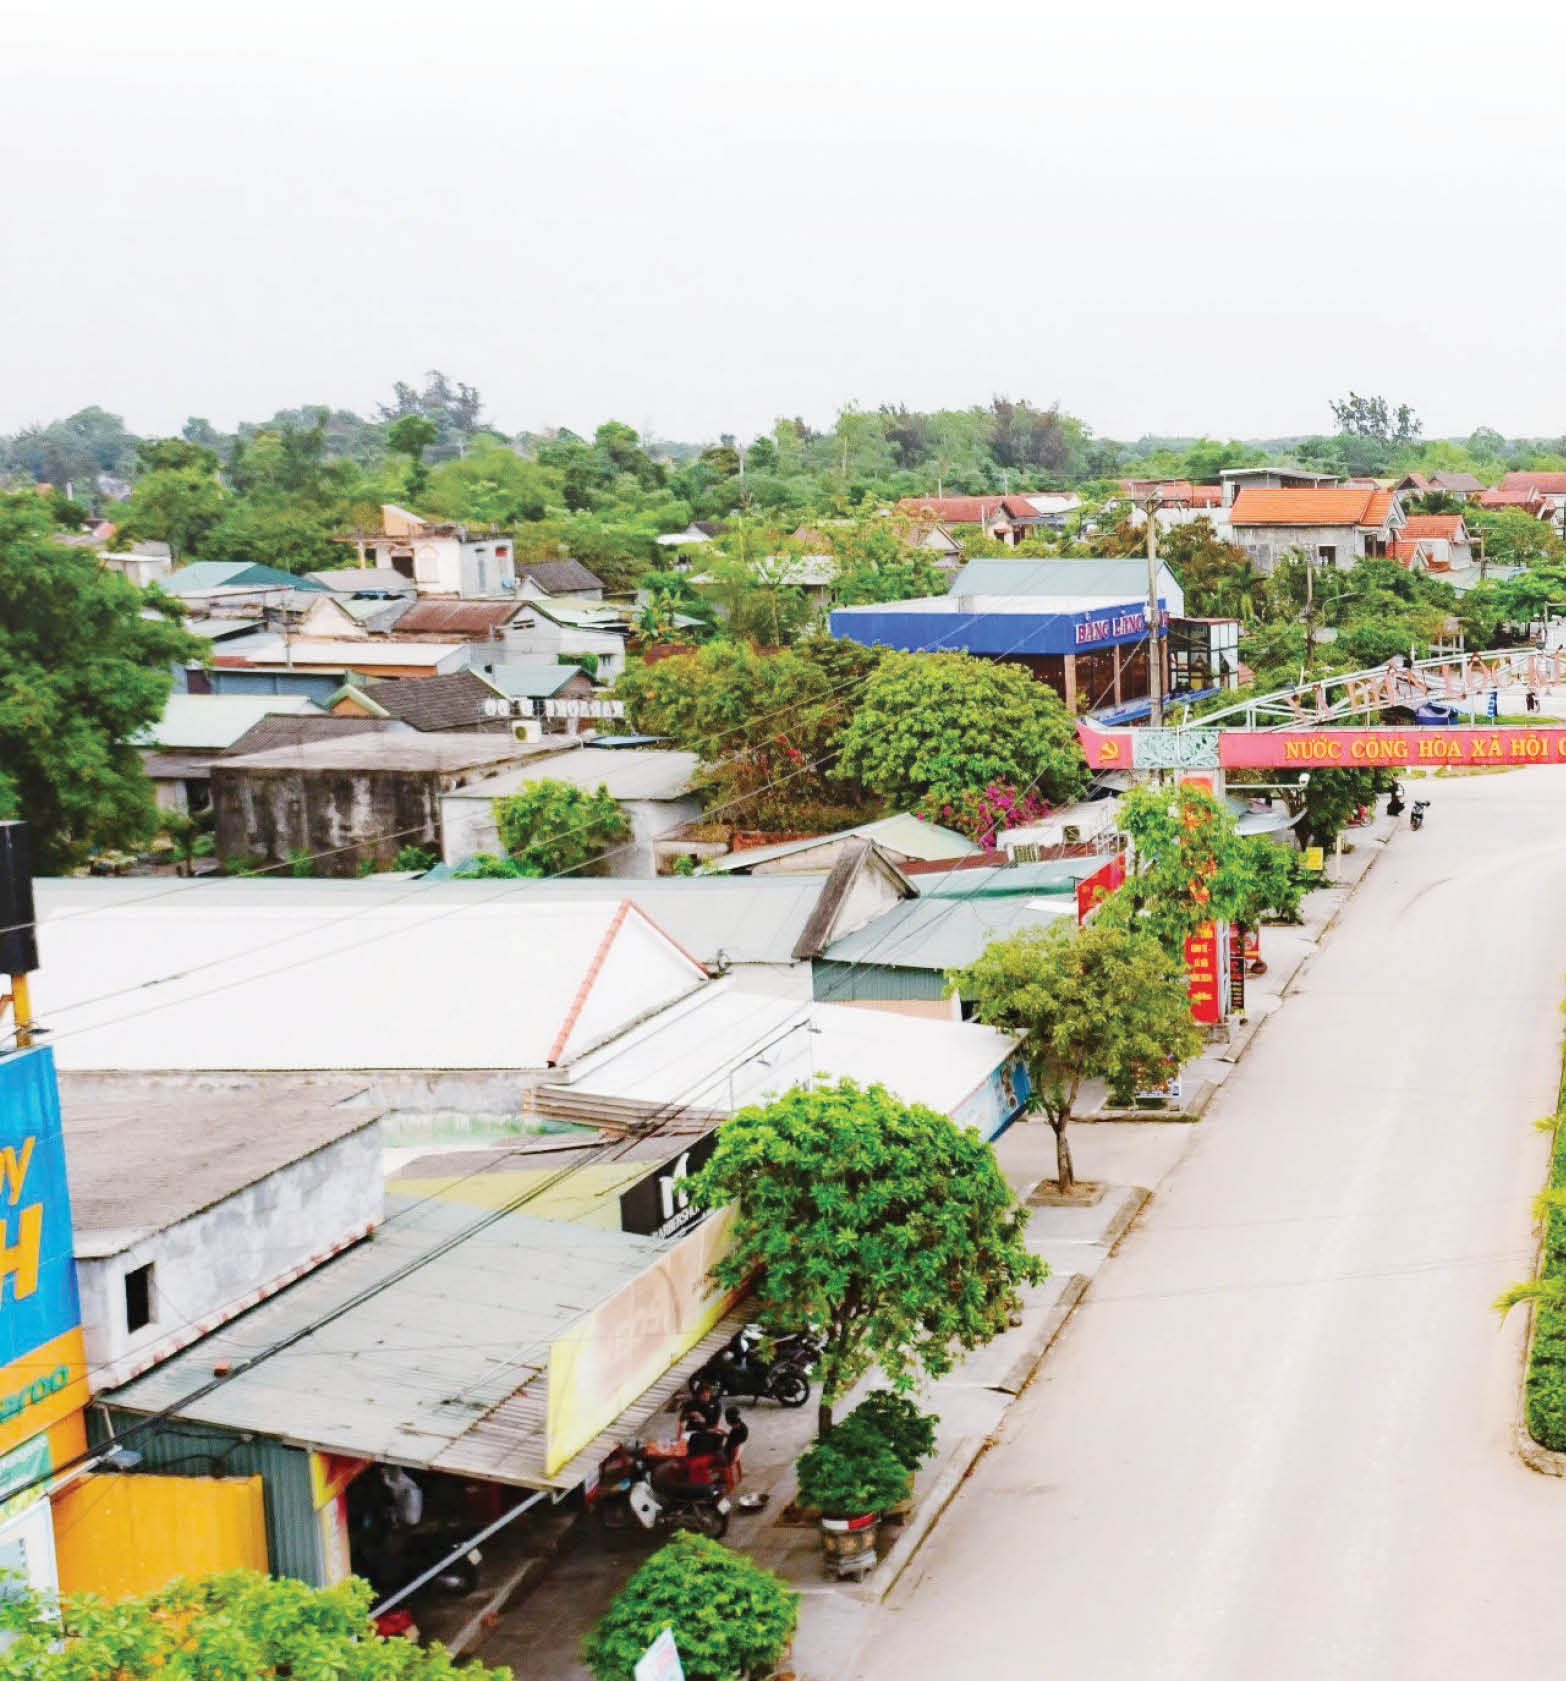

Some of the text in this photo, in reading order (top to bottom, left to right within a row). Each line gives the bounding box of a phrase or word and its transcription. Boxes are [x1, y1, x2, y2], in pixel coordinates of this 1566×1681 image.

[1285, 736, 1343, 760] NƯỚC
[1351, 736, 1408, 761] CỘNG
[1418, 736, 1463, 758] HÒA
[1471, 735, 1503, 756] XÃ
[1511, 735, 1548, 758] HỘI
